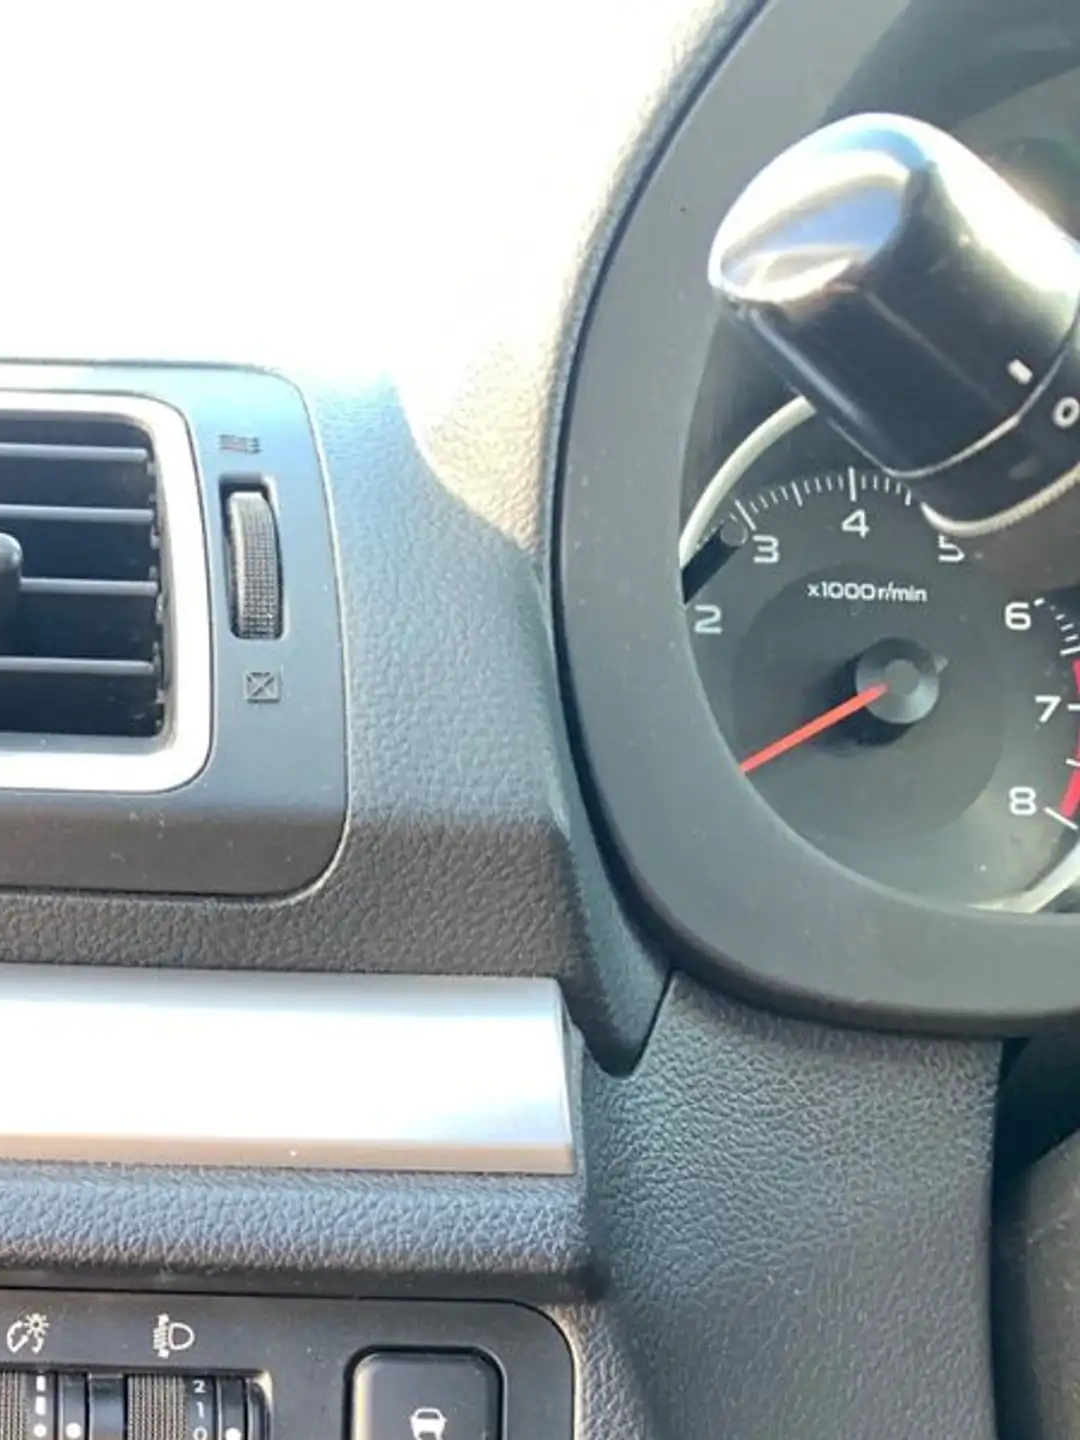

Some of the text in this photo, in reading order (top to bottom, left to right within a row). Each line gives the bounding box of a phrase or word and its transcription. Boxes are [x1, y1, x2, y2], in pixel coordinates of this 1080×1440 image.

[841, 509, 870, 537] 4
[752, 535, 780, 564] 3
[938, 534, 966, 562] 5
[807, 581, 929, 602] x1000 r/min
[693, 604, 723, 634] 2
[1004, 601, 1032, 630] 6
[1035, 696, 1061, 723] 7
[1008, 786, 1036, 816] 8
[192, 1380, 206, 1393] 2
[196, 1401, 205, 1418] 1
